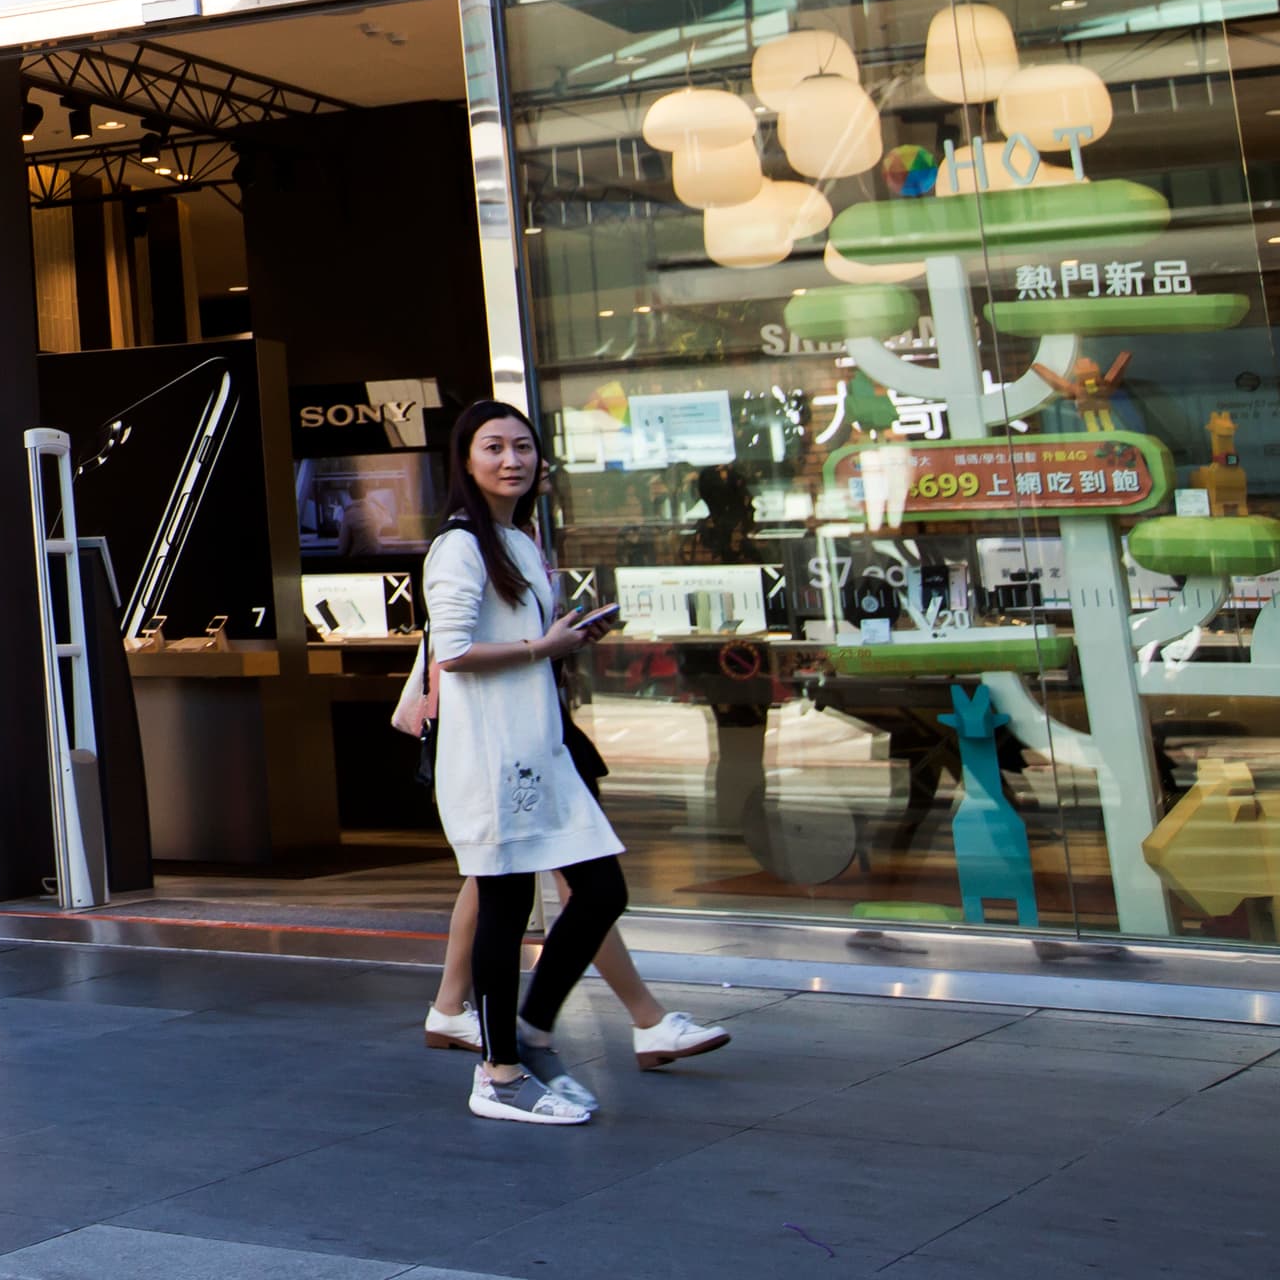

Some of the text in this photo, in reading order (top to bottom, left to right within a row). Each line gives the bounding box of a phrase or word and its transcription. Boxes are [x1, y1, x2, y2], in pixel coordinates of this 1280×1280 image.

[943, 126, 1093, 193] HOT
[1015, 260, 1193, 300] 熱門新品
[300, 400, 417, 428] SONY
[986, 469, 1140, 497] 上網吃到飽
[251, 607, 266, 628] 7
